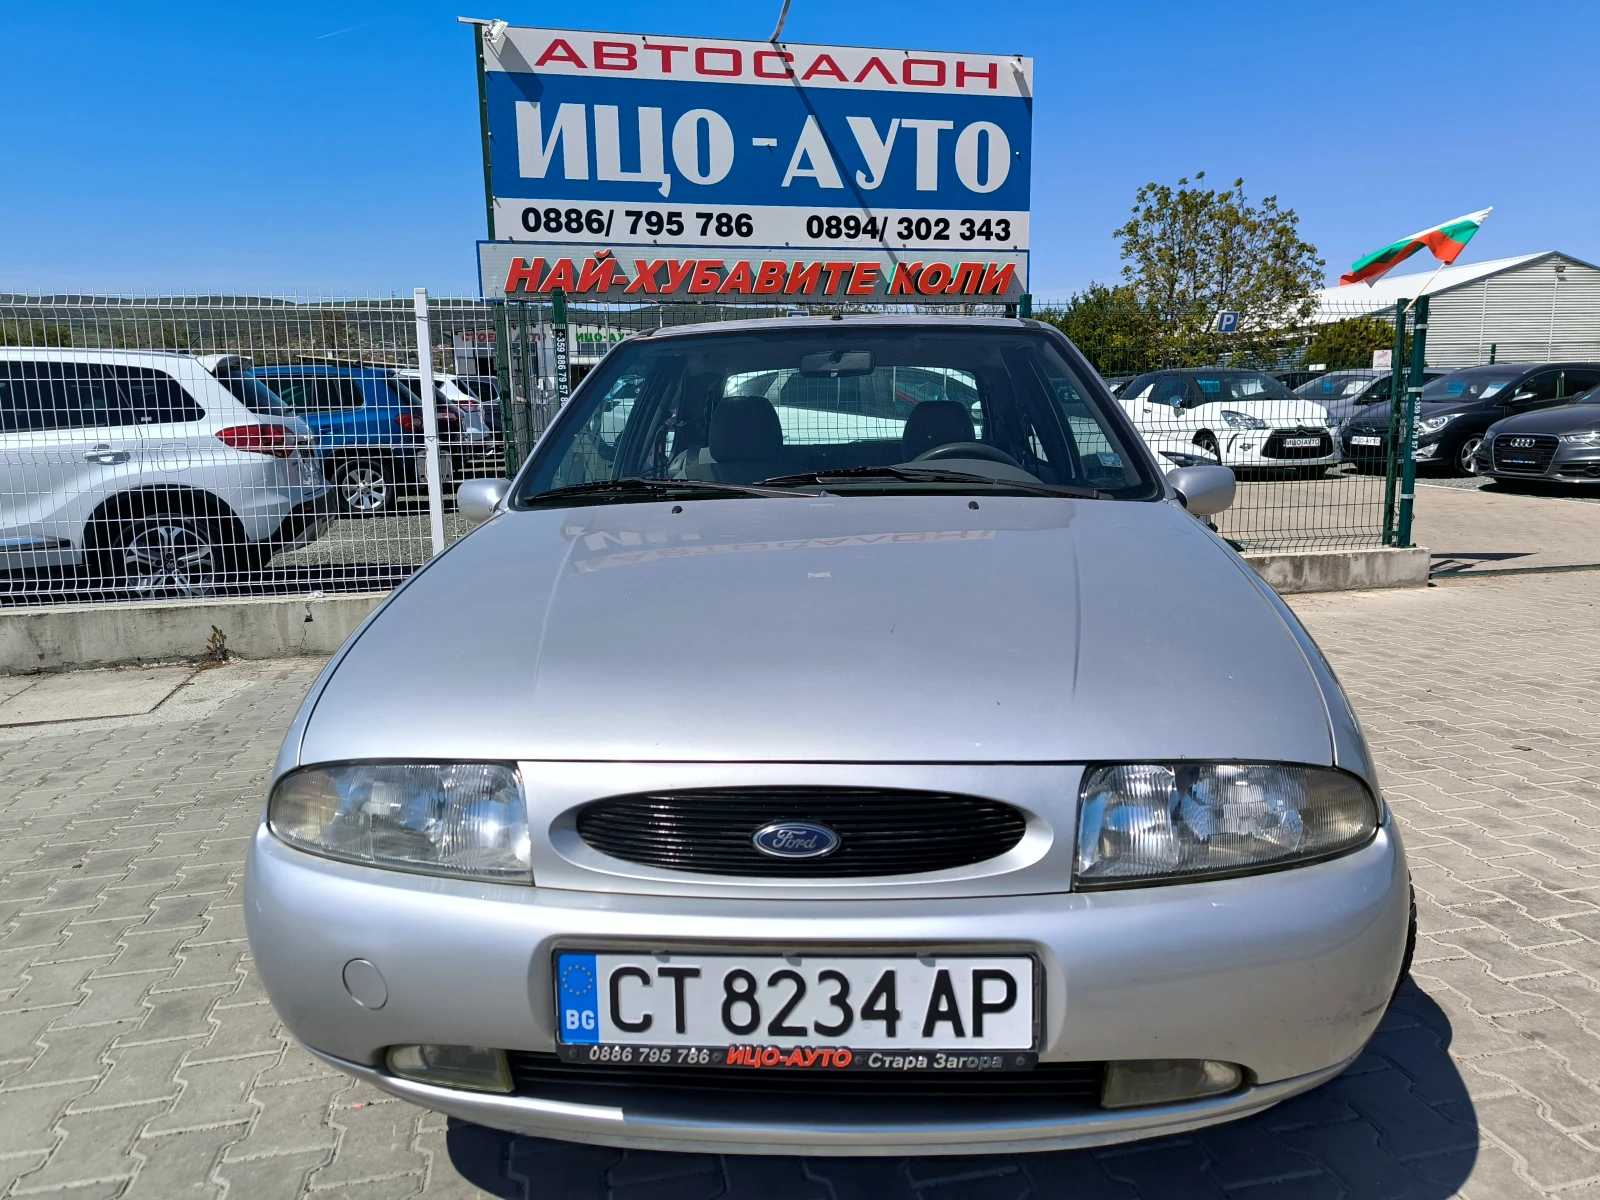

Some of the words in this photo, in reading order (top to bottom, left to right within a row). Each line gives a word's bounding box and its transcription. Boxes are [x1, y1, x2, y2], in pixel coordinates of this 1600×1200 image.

[535, 39, 998, 90] АВТОСАЛОН
[521, 207, 614, 237] 0886/
[624, 210, 684, 236] 795
[695, 212, 754, 237] 786
[806, 215, 888, 242] 0894/
[897, 217, 950, 241] 302
[959, 218, 1011, 241] 343
[504, 248, 881, 295] НАЙ-ХУБАВИТЕ
[889, 261, 1016, 295] КОЛИ
[1222, 314, 1234, 330] P
[461, 333, 497, 343] СТОЕ
[556, 332, 566, 352] +359
[557, 355, 566, 370] 886
[558, 372, 568, 383] 79
[559, 385, 569, 395] 57
[772, 829, 818, 849] Ford
[721, 967, 901, 1038] 8234
[566, 1010, 595, 1030] BG
[589, 1046, 632, 1062] 0886
[638, 1048, 671, 1063] 795
[677, 1048, 710, 1064] 786
[726, 1045, 852, 1068] ИЦО-АУТО
[867, 1053, 928, 1070] Стара
[933, 1054, 1003, 1071] Загора
